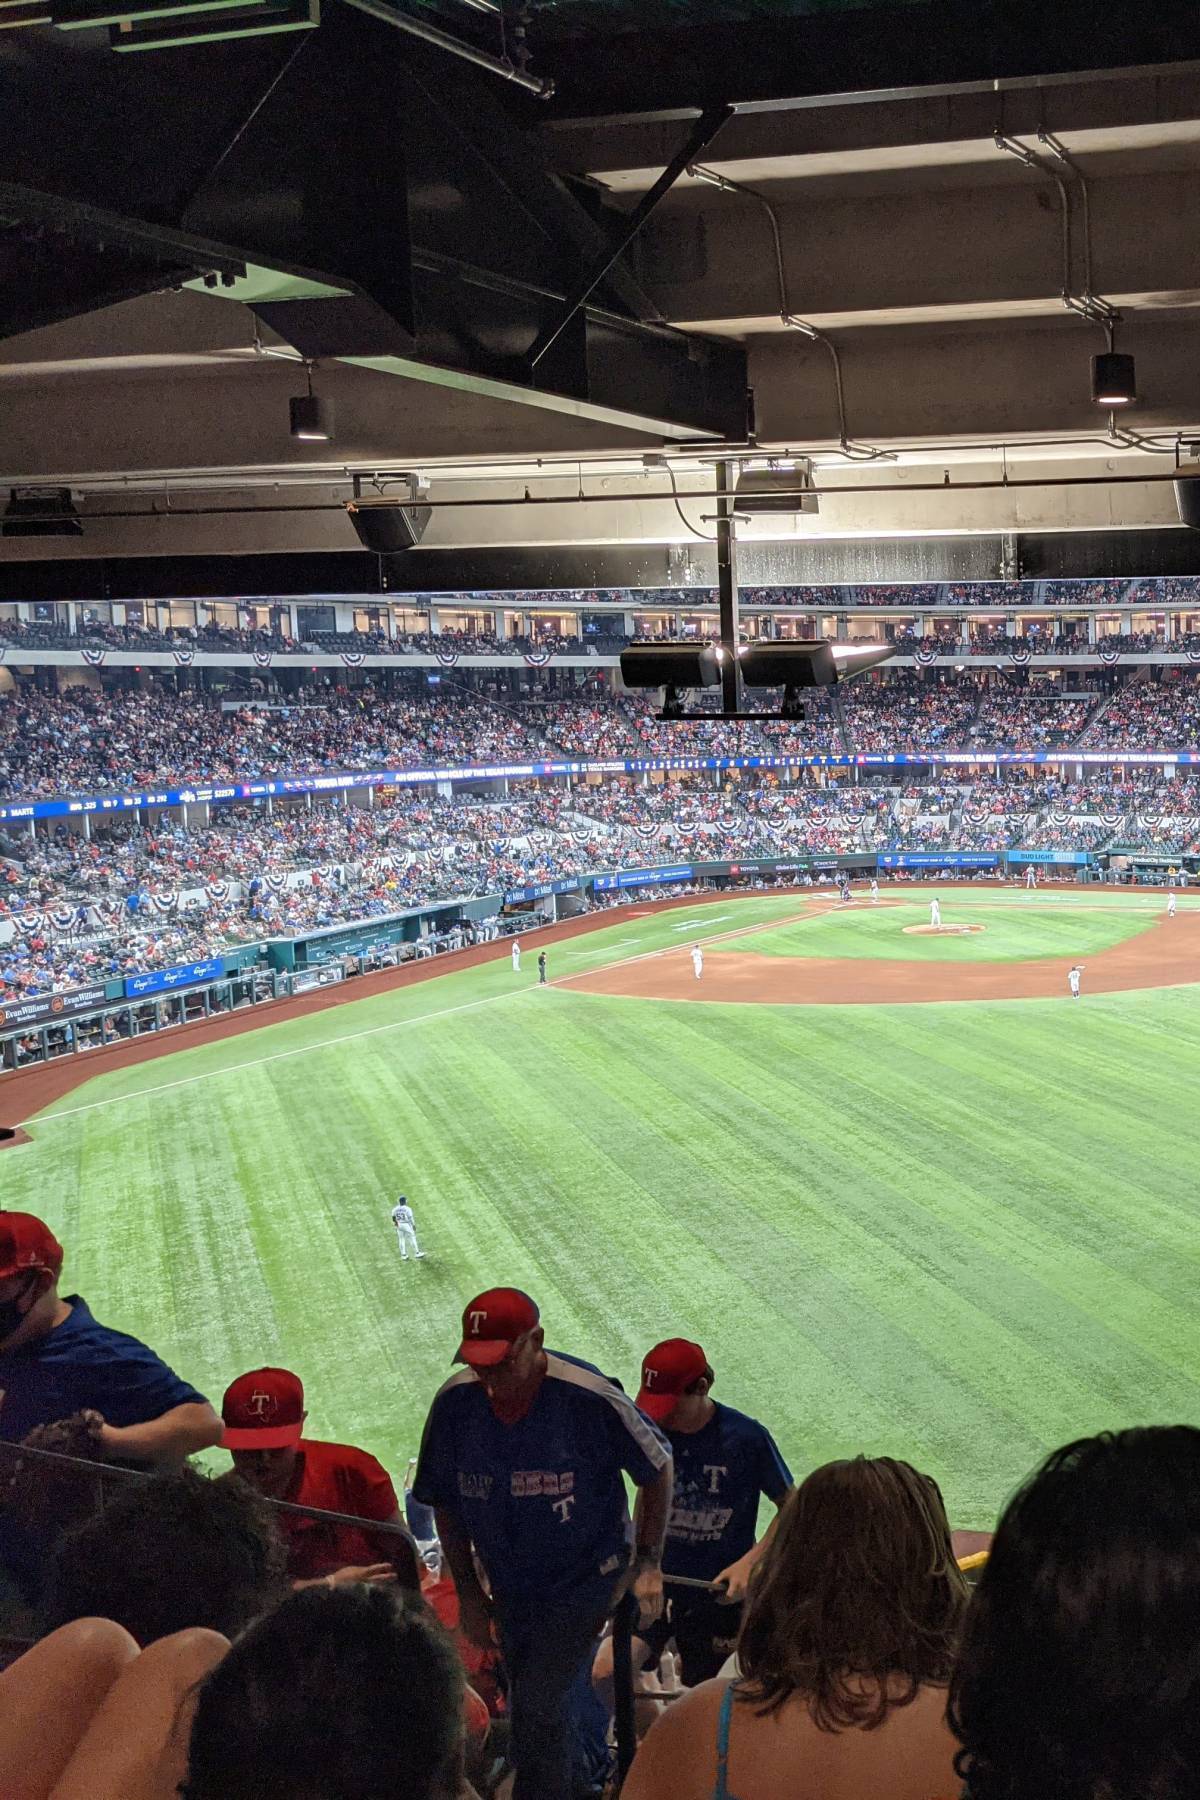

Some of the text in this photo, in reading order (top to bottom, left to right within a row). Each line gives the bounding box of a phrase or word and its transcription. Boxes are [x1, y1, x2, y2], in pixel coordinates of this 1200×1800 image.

[945, 754, 975, 762] TOYOTA
[407, 771, 436, 781] OFFICIAL
[11, 808, 34, 817] MARTE
[194, 967, 207, 977] Kroger
[164, 973, 177, 983] Kroger
[134, 980, 148, 991] Kroger
[470, 1311, 488, 1335] T
[645, 1368, 659, 1388] T
[251, 1394, 270, 1415] T
[703, 1464, 727, 1493] T
[552, 1494, 575, 1524] T
